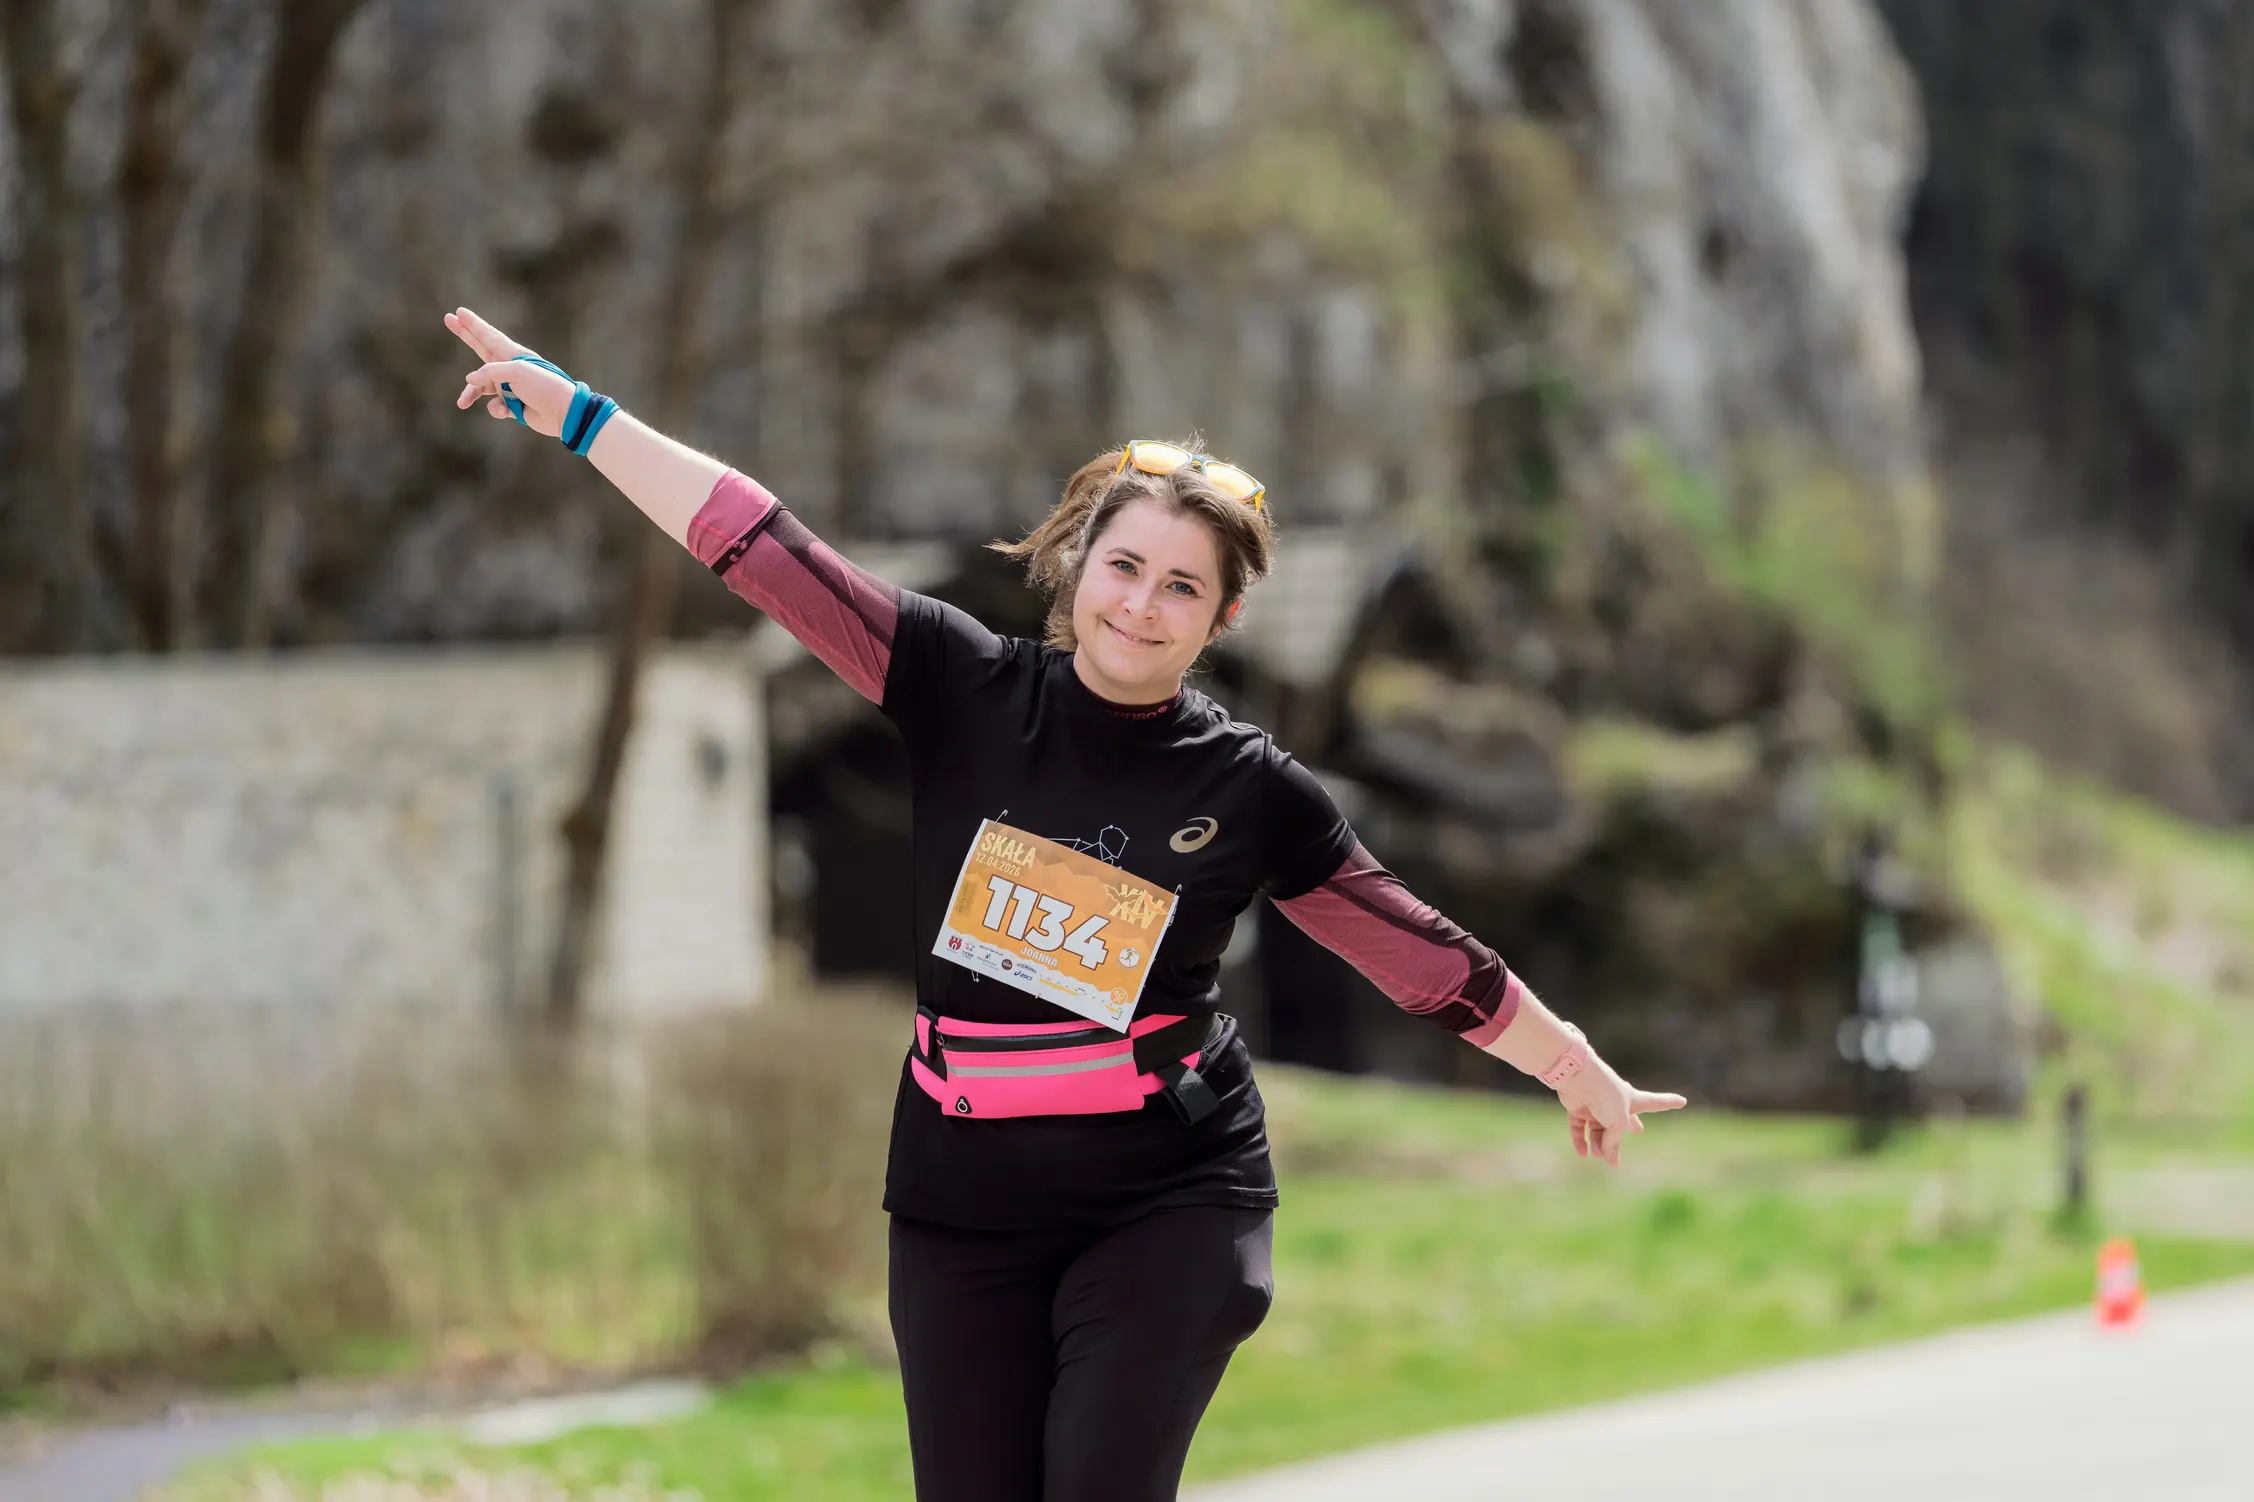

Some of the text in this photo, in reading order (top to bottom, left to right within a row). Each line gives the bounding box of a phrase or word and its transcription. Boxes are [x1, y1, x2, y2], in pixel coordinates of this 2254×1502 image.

[976, 852, 1021, 877] 12.04.2026
[981, 832, 1036, 869] SKAŁA
[982, 874, 1111, 971] 1134
[1021, 946, 1058, 967] JOANNA
